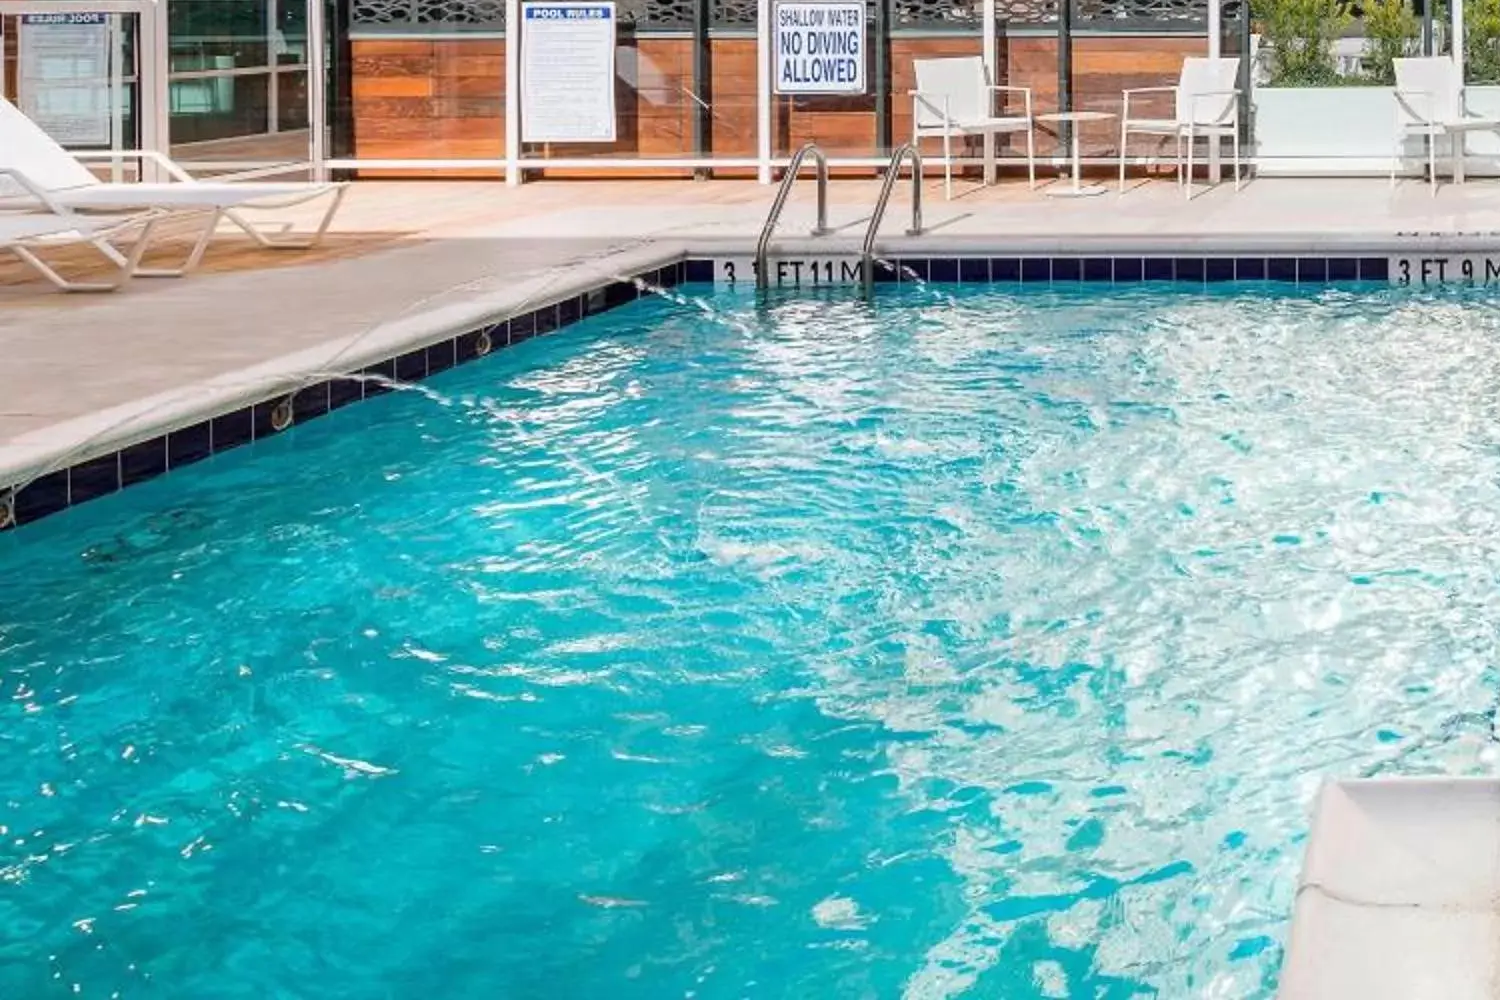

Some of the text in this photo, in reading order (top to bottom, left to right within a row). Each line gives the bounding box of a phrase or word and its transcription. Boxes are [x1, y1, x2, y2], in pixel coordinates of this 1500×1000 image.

[534, 9, 602, 18] POOL RULES
[780, 10, 859, 26] SHALLOW WATER
[781, 32, 858, 54] NO DIVING
[783, 59, 857, 82] ALLOWED
[777, 261, 804, 287] FT
[1399, 259, 1410, 286] 3
[1421, 258, 1448, 285] FT
